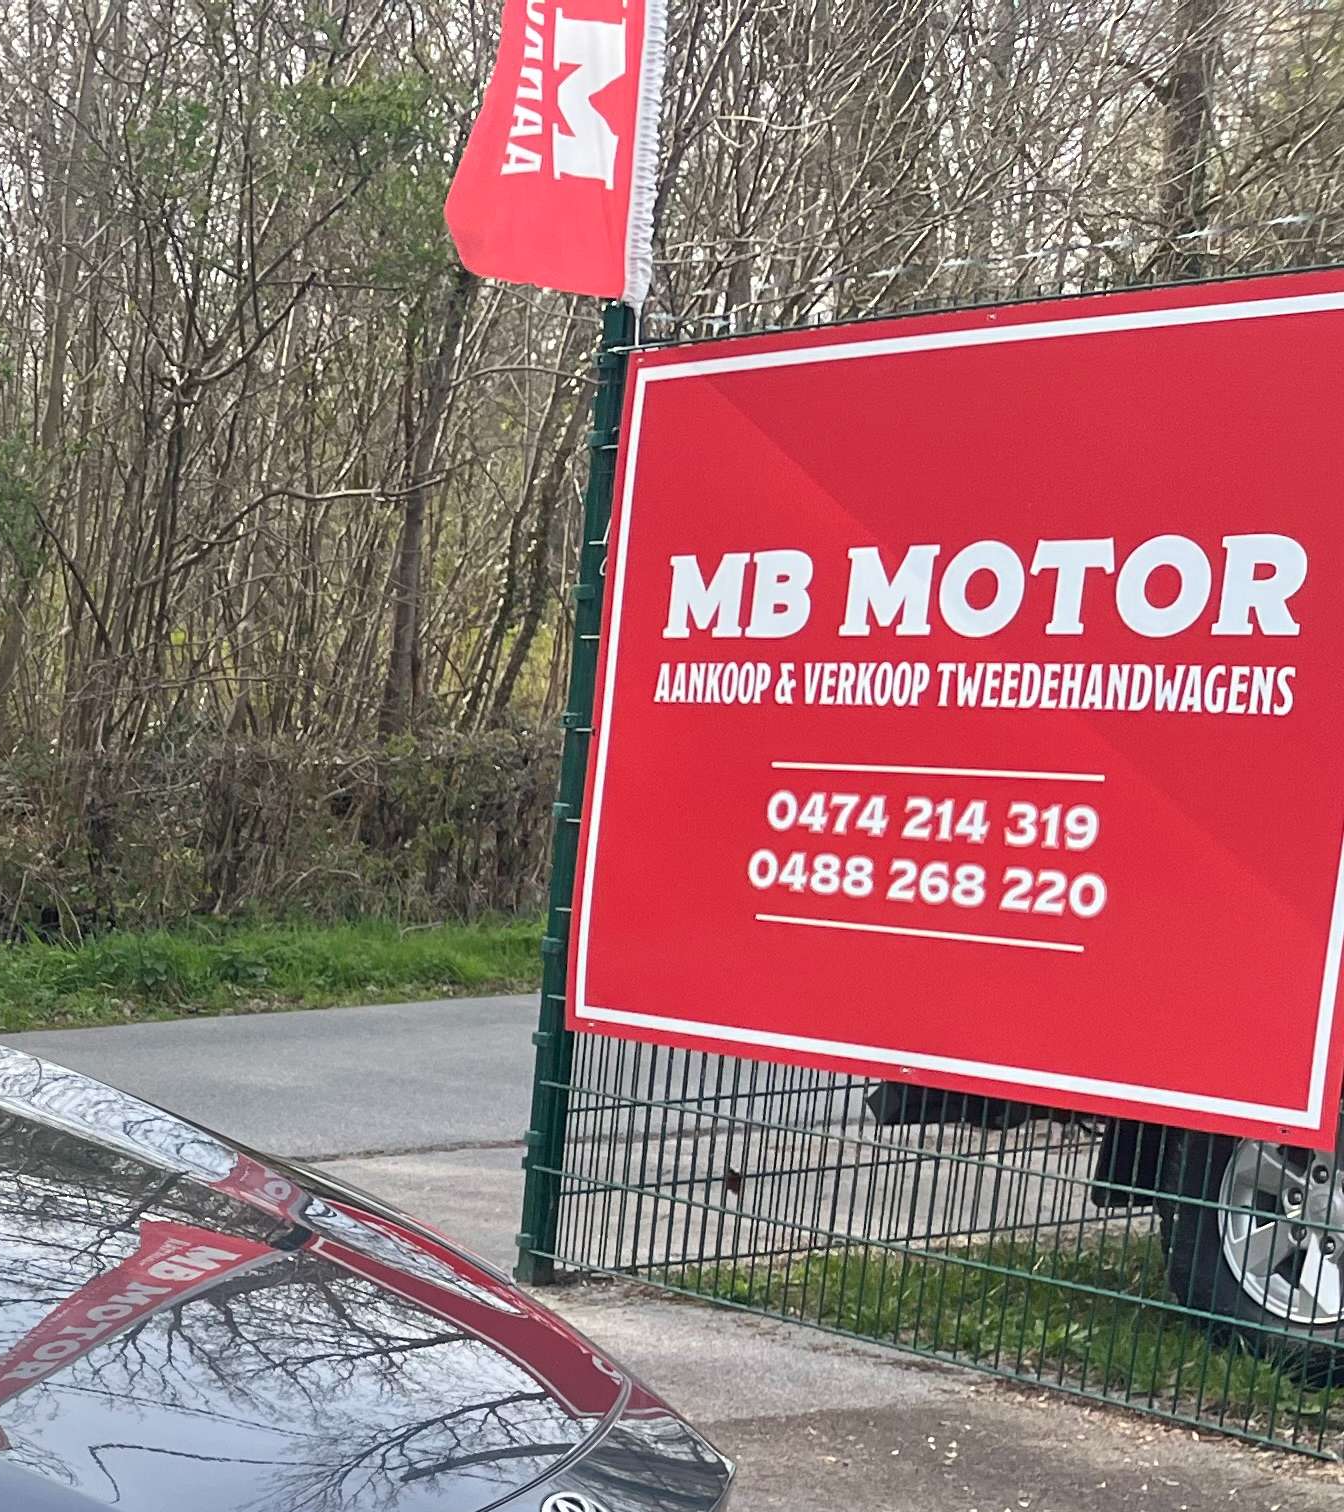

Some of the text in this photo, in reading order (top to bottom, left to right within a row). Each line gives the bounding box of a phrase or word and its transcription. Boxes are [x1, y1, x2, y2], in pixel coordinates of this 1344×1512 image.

[663, 533, 1308, 639] MB MOTOR
[653, 661, 1296, 716] AANKOOP & VERKOOP TWEEDEHANDWAGENS
[766, 789, 1100, 850] 0474 214 319
[747, 849, 1108, 918] 0488 268 220
